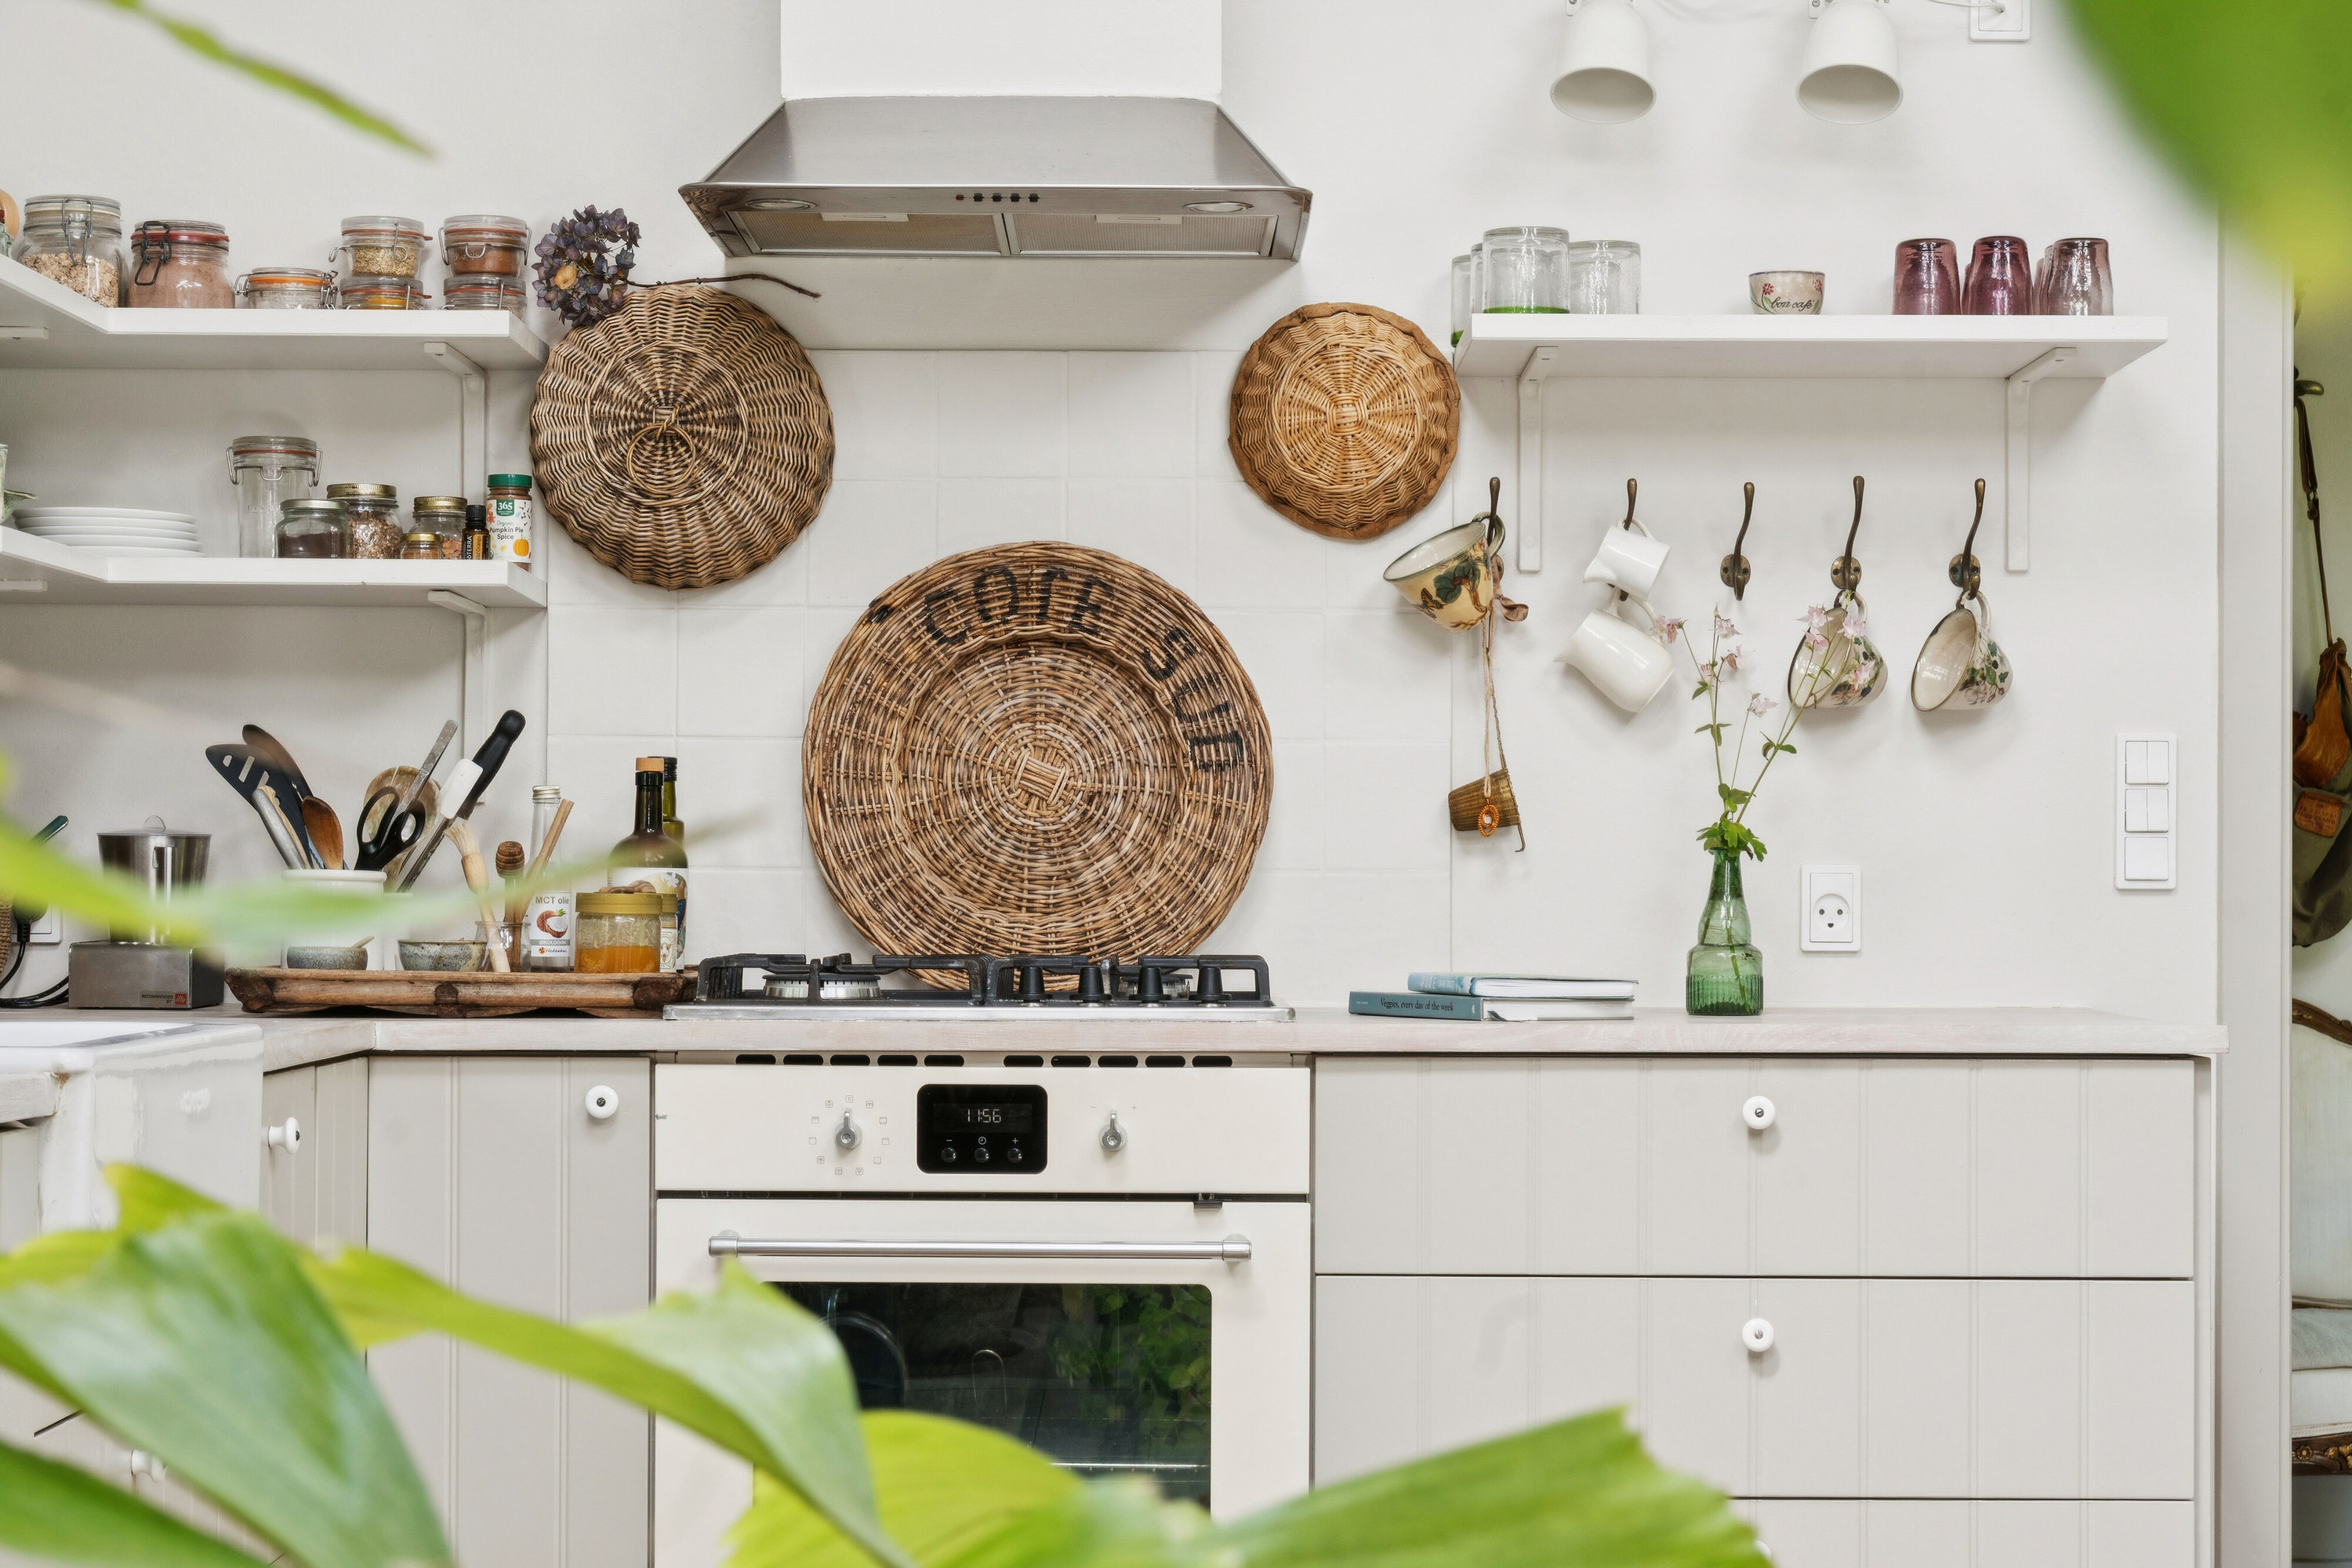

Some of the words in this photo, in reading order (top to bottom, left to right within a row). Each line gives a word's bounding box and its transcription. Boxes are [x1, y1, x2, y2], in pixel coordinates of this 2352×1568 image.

[1771, 296, 1791, 308] bon
[1791, 299, 1815, 311] café
[498, 502, 513, 510] 365
[557, 896, 570, 905] olie
[1380, 997, 1399, 1010] Veggies,
[1400, 999, 1414, 1010] every
[1414, 1000, 1425, 1011] day
[1425, 1001, 1431, 1010] of
[1431, 1001, 1440, 1010] the
[1440, 1003, 1454, 1011] week
[967, 1109, 1002, 1123] 11:56
